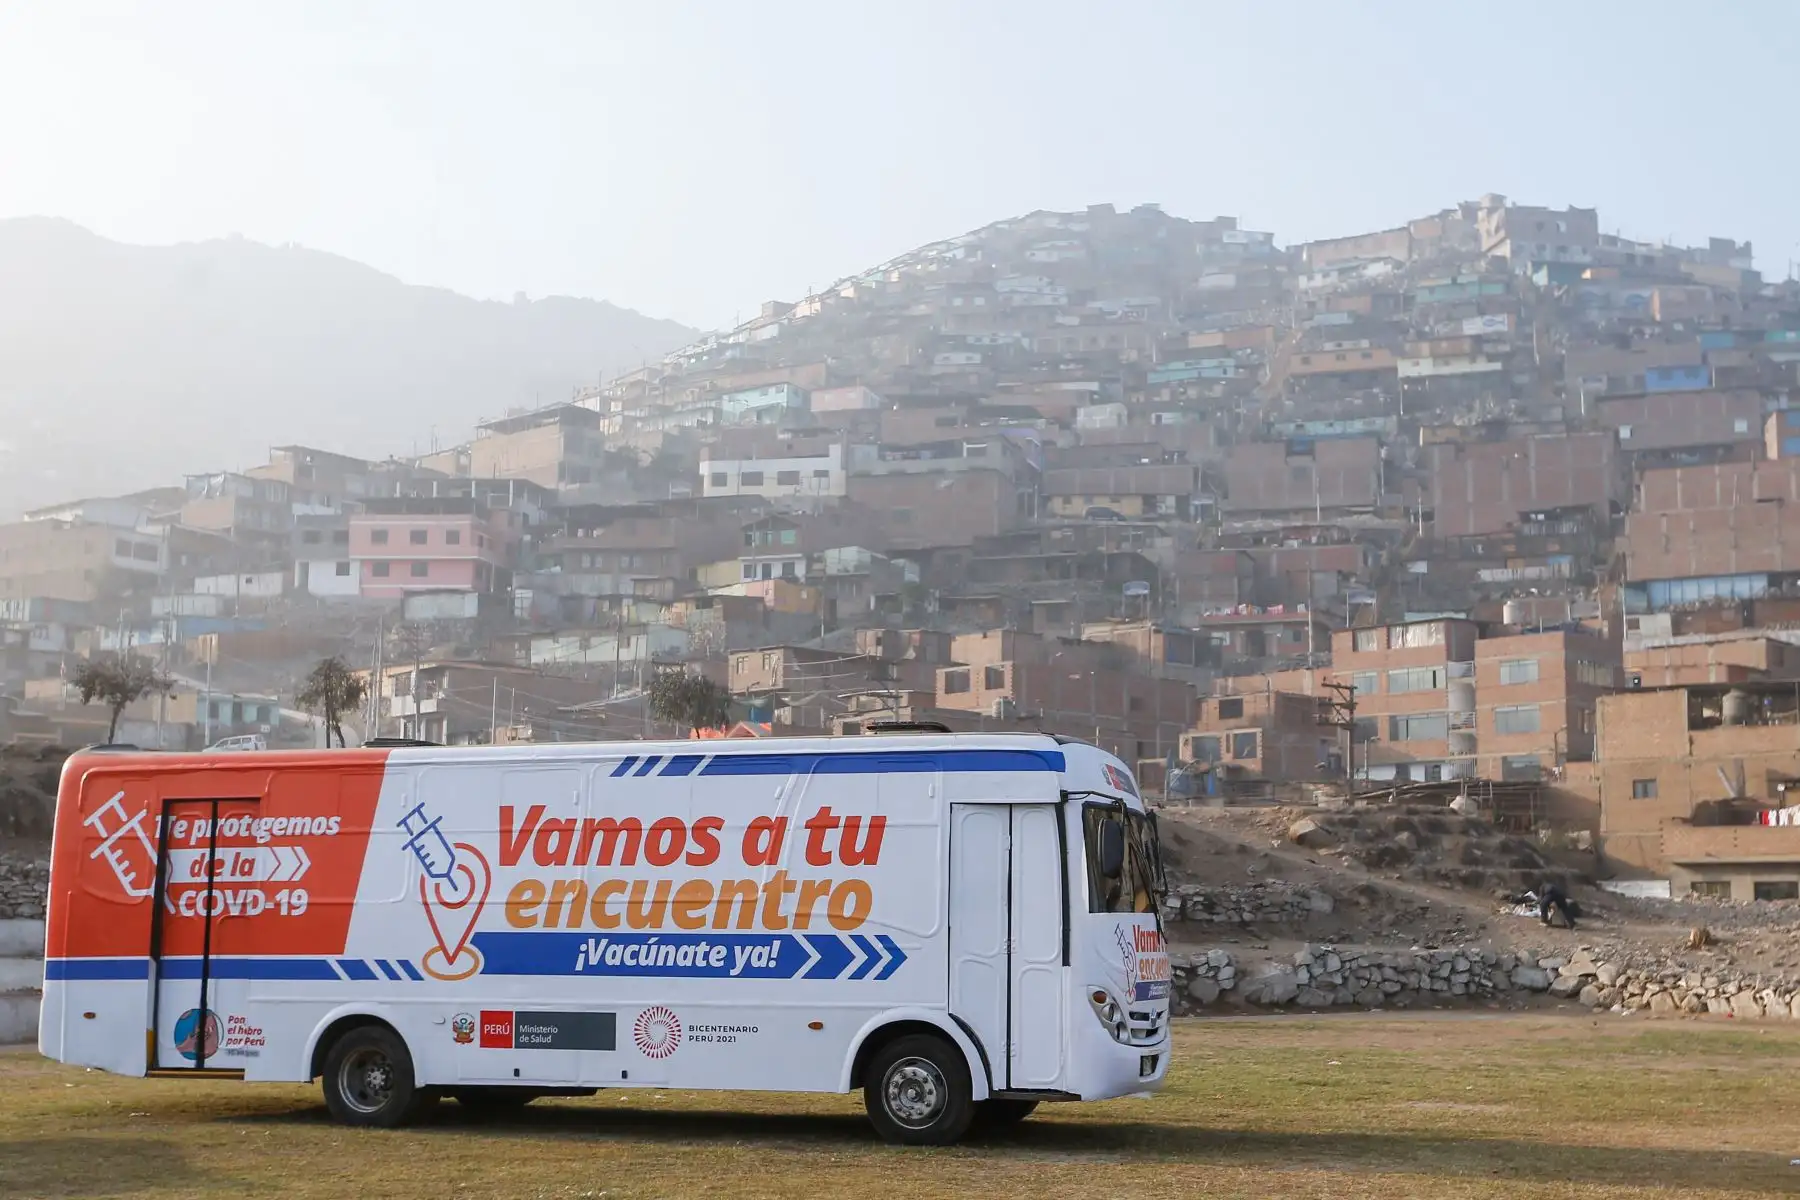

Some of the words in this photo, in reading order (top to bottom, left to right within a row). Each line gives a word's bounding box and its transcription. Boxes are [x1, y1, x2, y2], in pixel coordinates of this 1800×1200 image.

[499, 805, 726, 867] Vamos
[742, 815, 789, 867] a
[804, 806, 887, 867] tu
[230, 852, 256, 877] la
[505, 869, 873, 931] encuentro
[574, 936, 728, 972] ¡Vacúnate
[729, 939, 781, 976] ya!
[484, 1022, 510, 1035] PERÚ
[519, 1025, 559, 1034] Ministerio
[688, 1025, 759, 1033] BICENTENARIO
[225, 1038, 243, 1047] por
[244, 1036, 265, 1046] Perú
[519, 1034, 529, 1043] de
[530, 1034, 552, 1043] Salud
[688, 1034, 714, 1043] PERÚ
[716, 1035, 737, 1043] 2021
